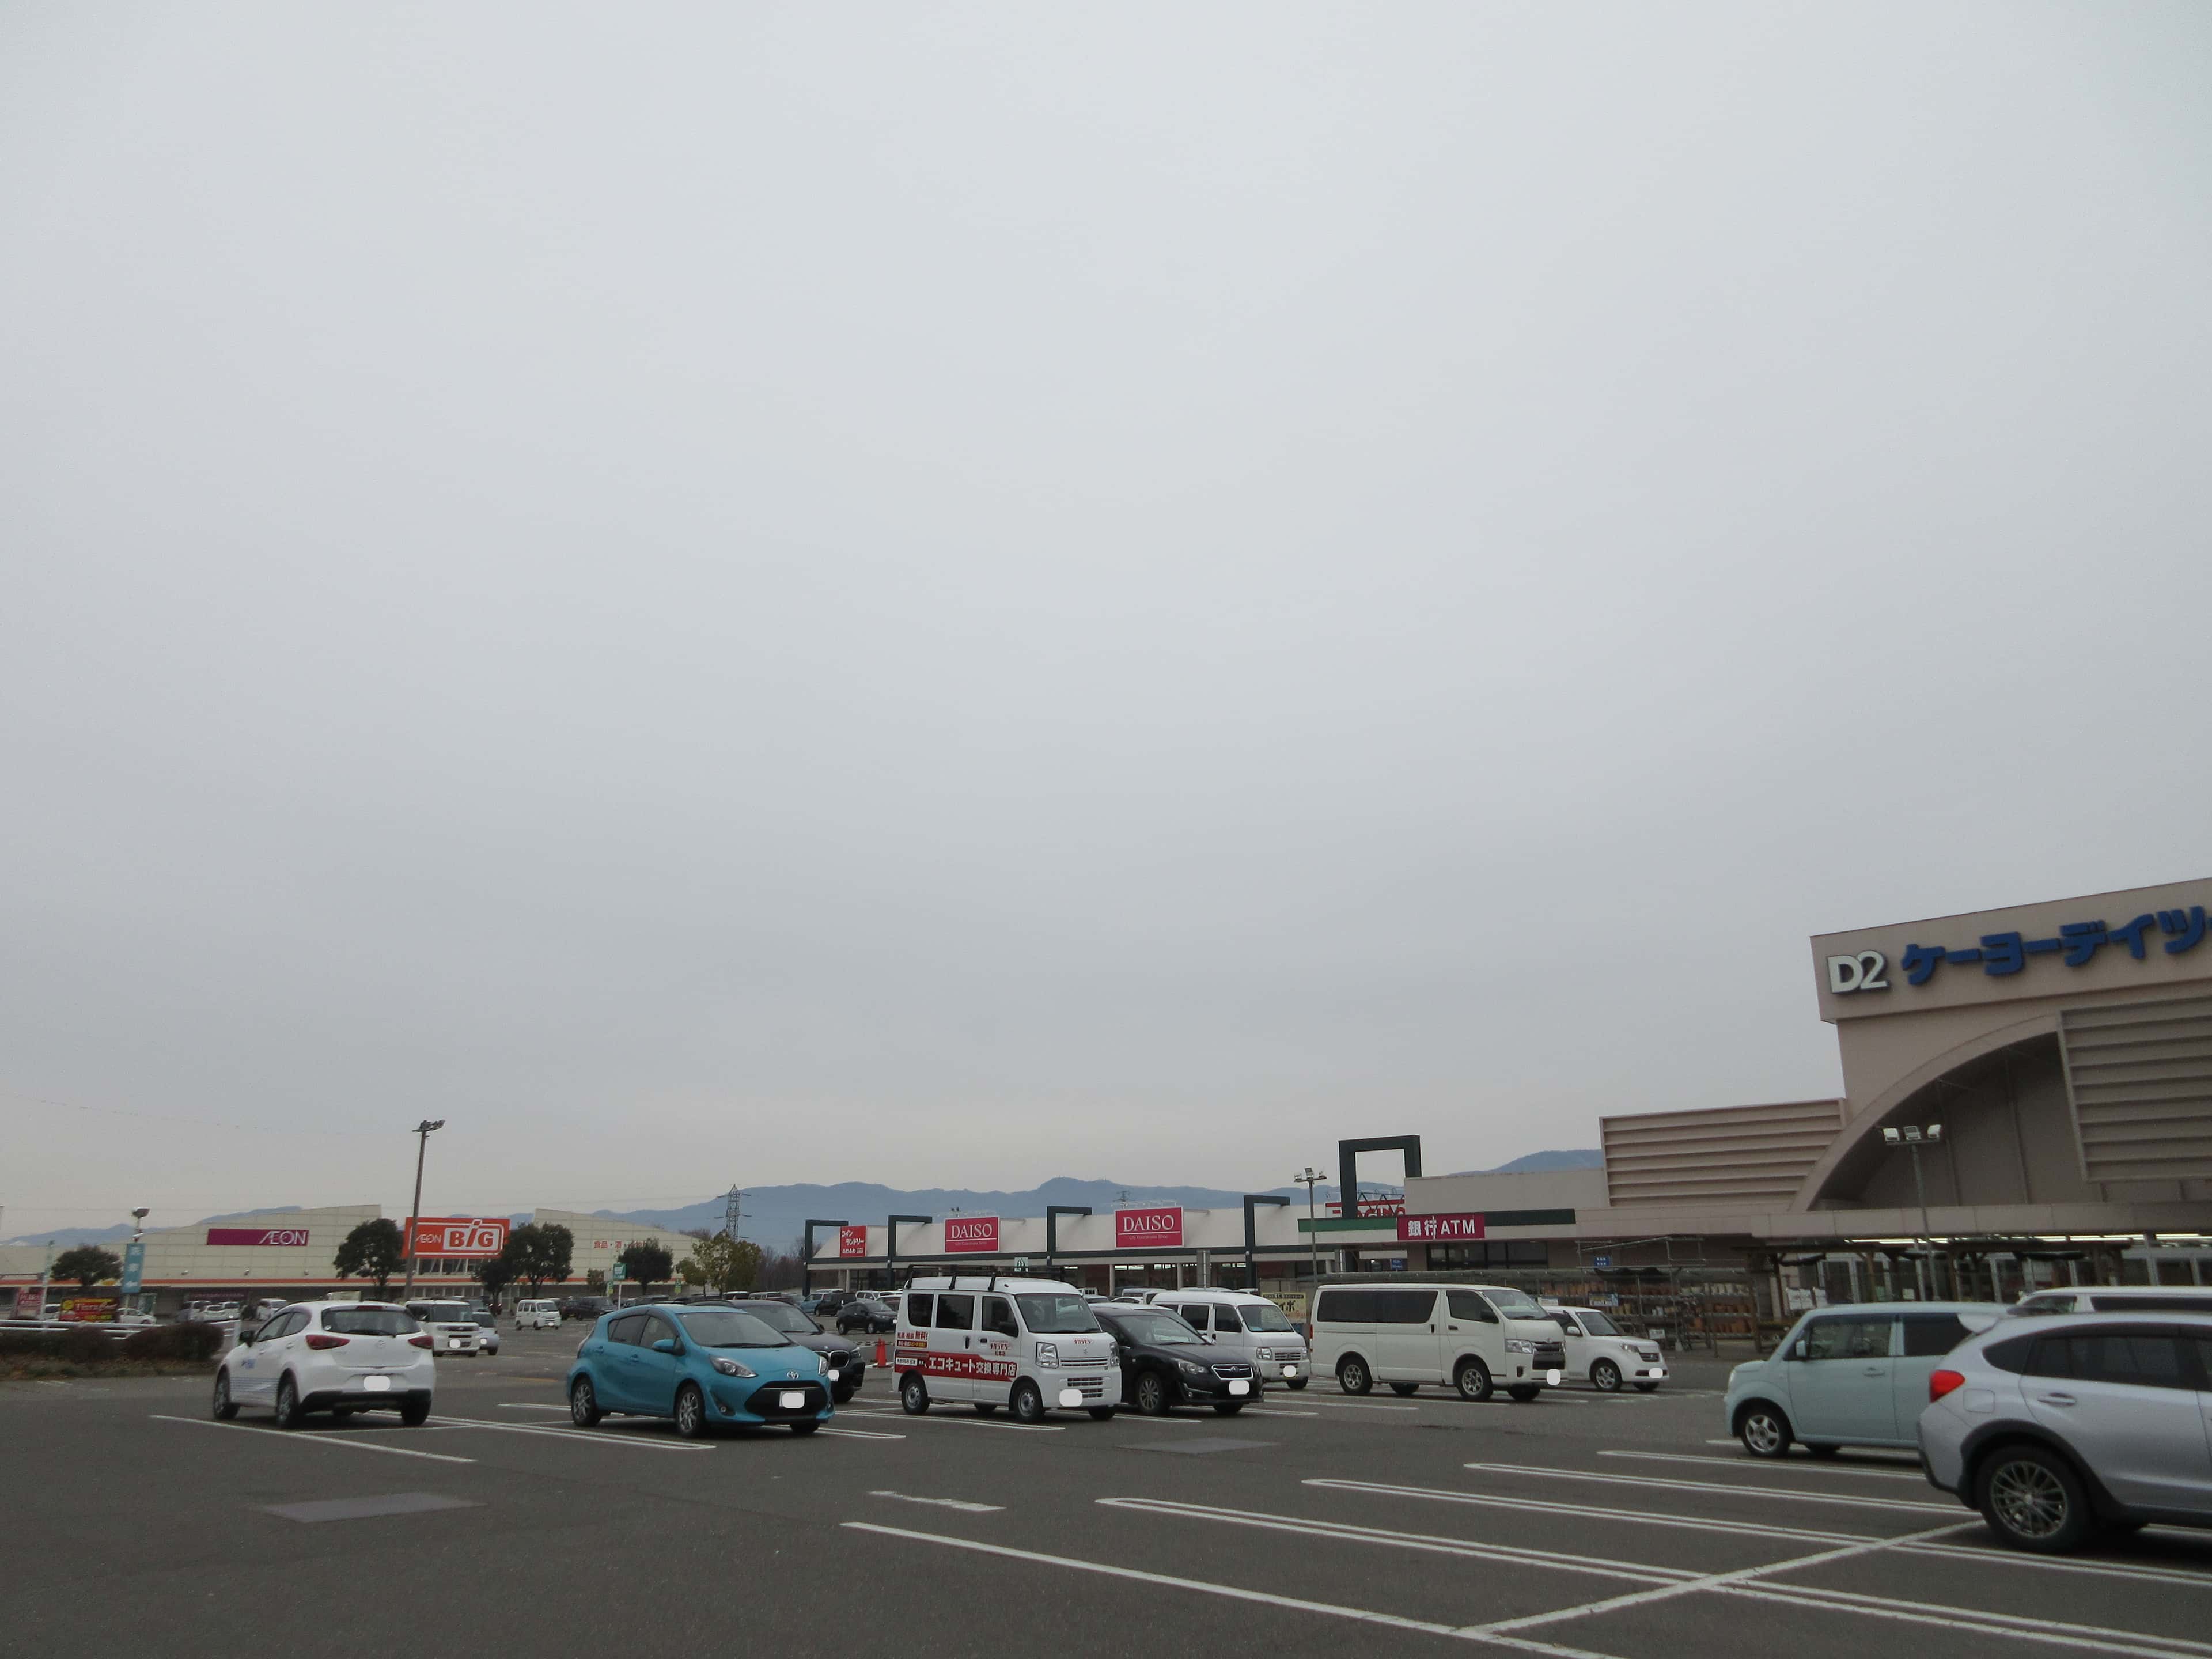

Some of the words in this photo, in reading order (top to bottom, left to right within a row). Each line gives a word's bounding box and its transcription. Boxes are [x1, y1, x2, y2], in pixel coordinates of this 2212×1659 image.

[1827, 949, 1889, 994] D2
[1902, 905, 2212, 986] ケーヨーデイツ
[951, 1223, 993, 1238] DAISO
[1122, 1214, 1175, 1232] DAISO
[1408, 1219, 1476, 1237] 銀行ATM
[846, 1238, 865, 1246] ランドリー
